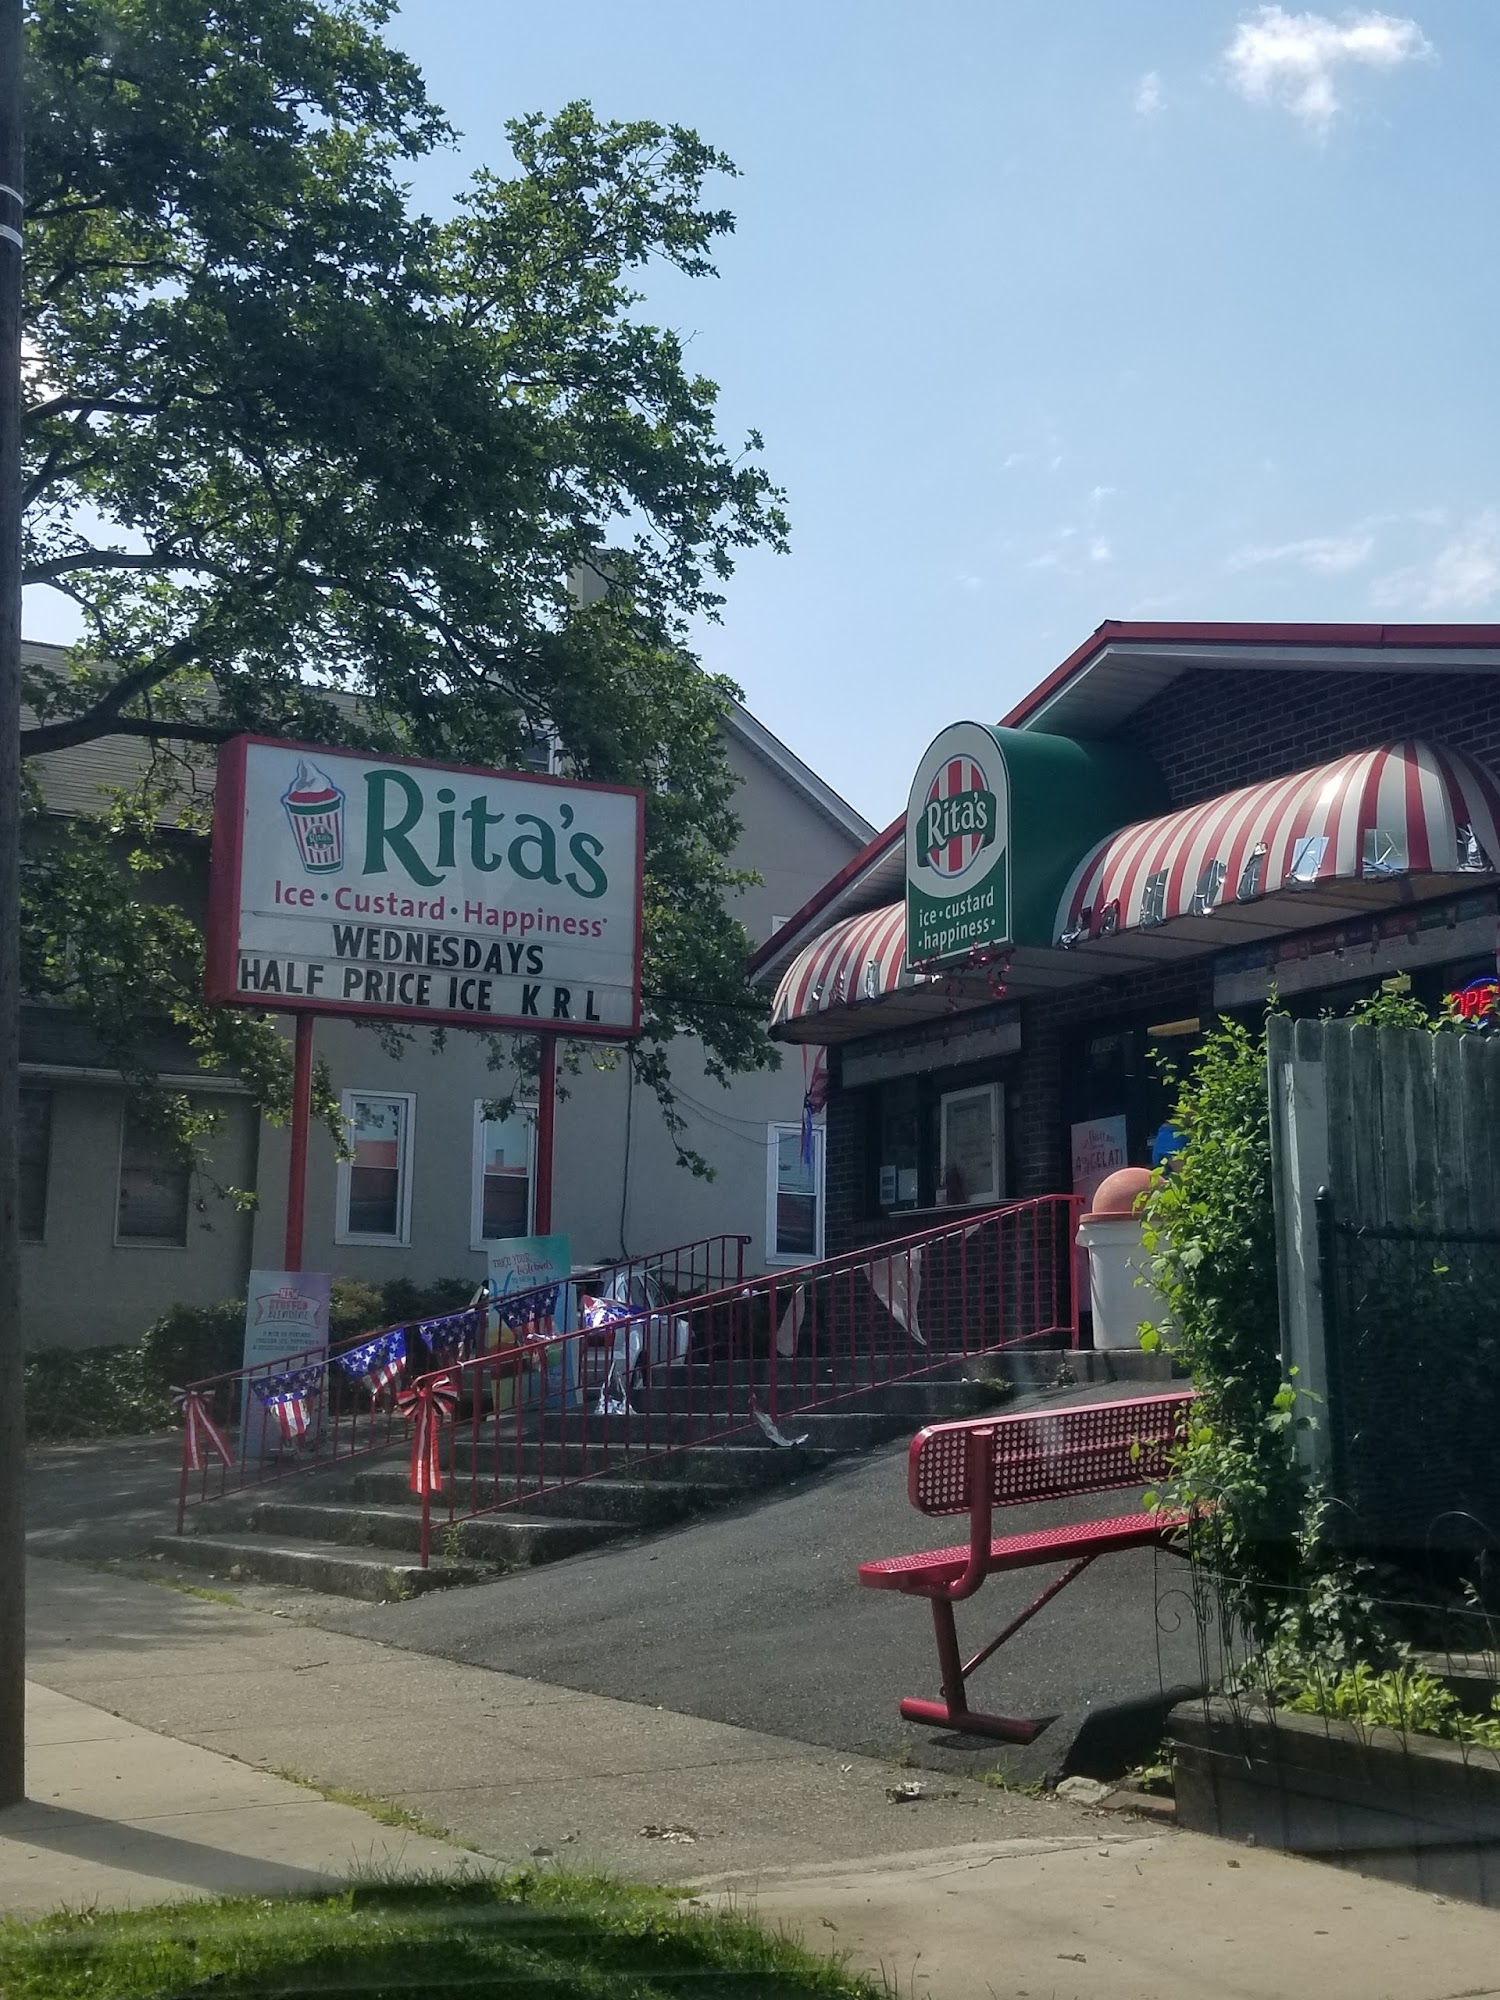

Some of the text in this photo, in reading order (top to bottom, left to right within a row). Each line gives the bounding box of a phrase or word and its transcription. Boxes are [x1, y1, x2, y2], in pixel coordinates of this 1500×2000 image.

[362, 769, 609, 899] Rita's
[926, 791, 988, 849] Rita's
[333, 924, 545, 975] WEDNESDAYS
[241, 959, 600, 1021] HALF PRICE ICE K R L
[1451, 986, 1500, 1018] OPE
